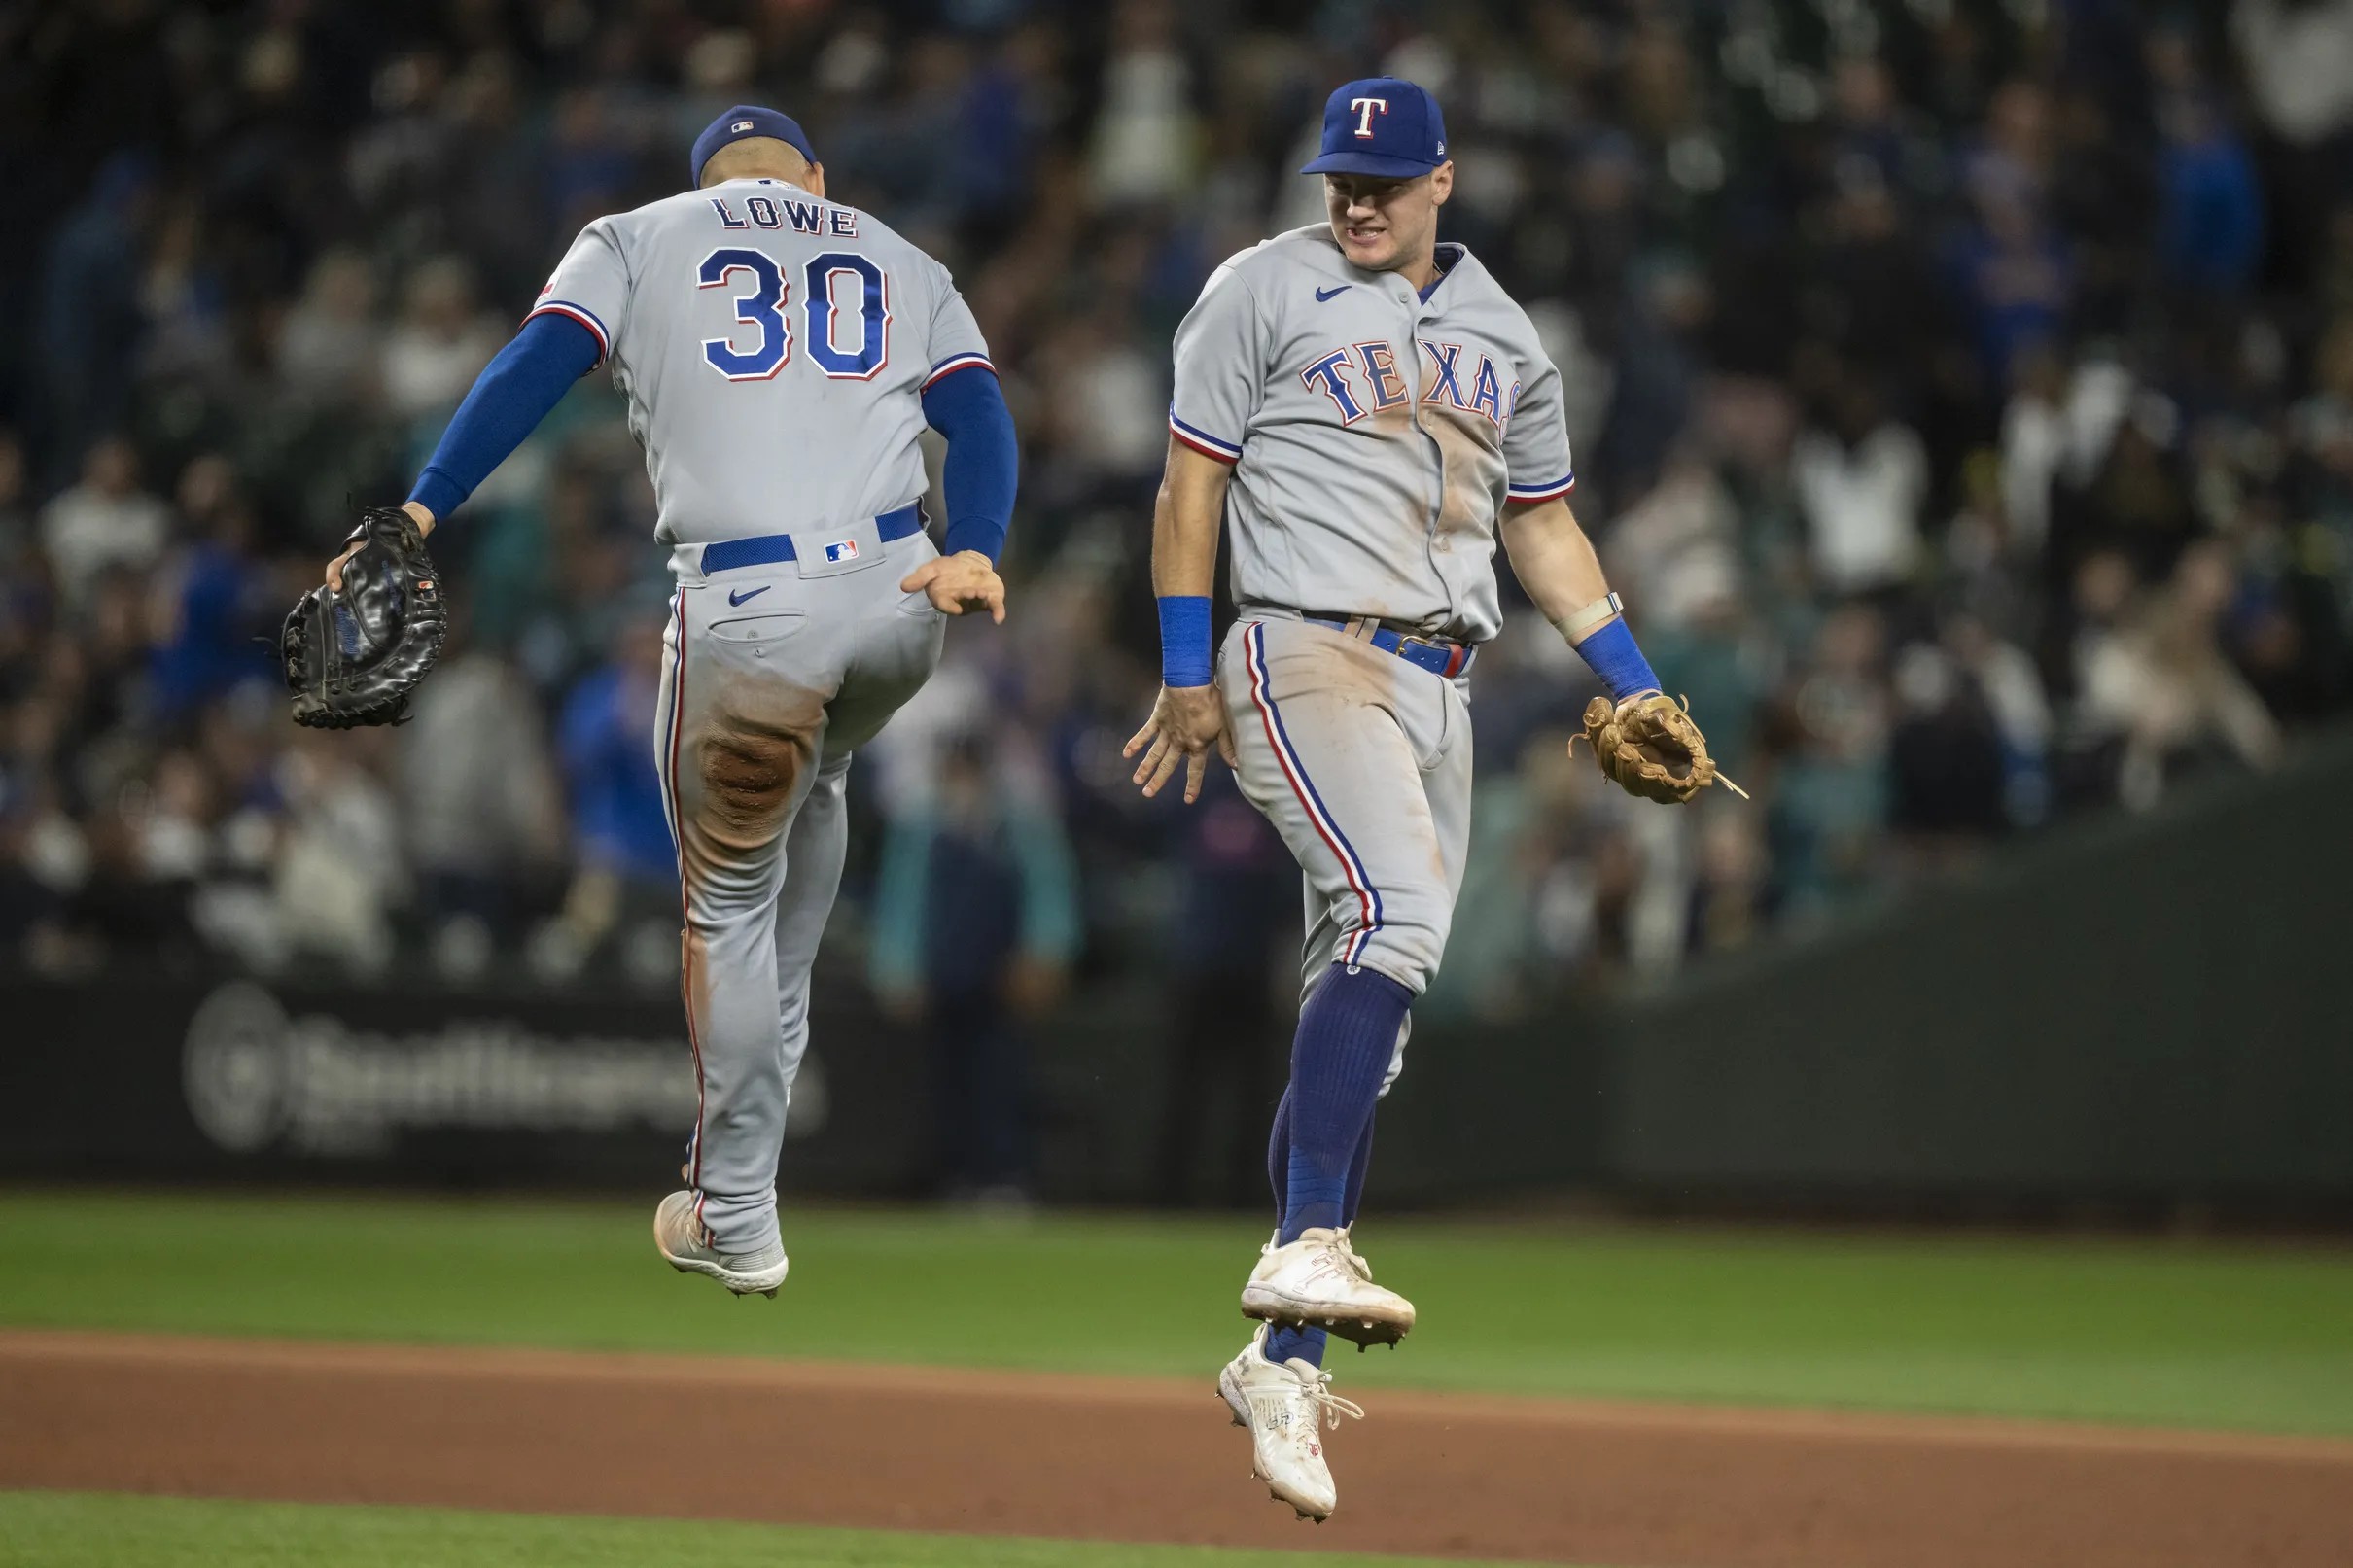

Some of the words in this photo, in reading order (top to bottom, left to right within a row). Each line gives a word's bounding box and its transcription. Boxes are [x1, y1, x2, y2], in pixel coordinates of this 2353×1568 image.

[1351, 97, 1388, 139] T
[707, 197, 858, 238] LOWE
[695, 247, 893, 382] 30
